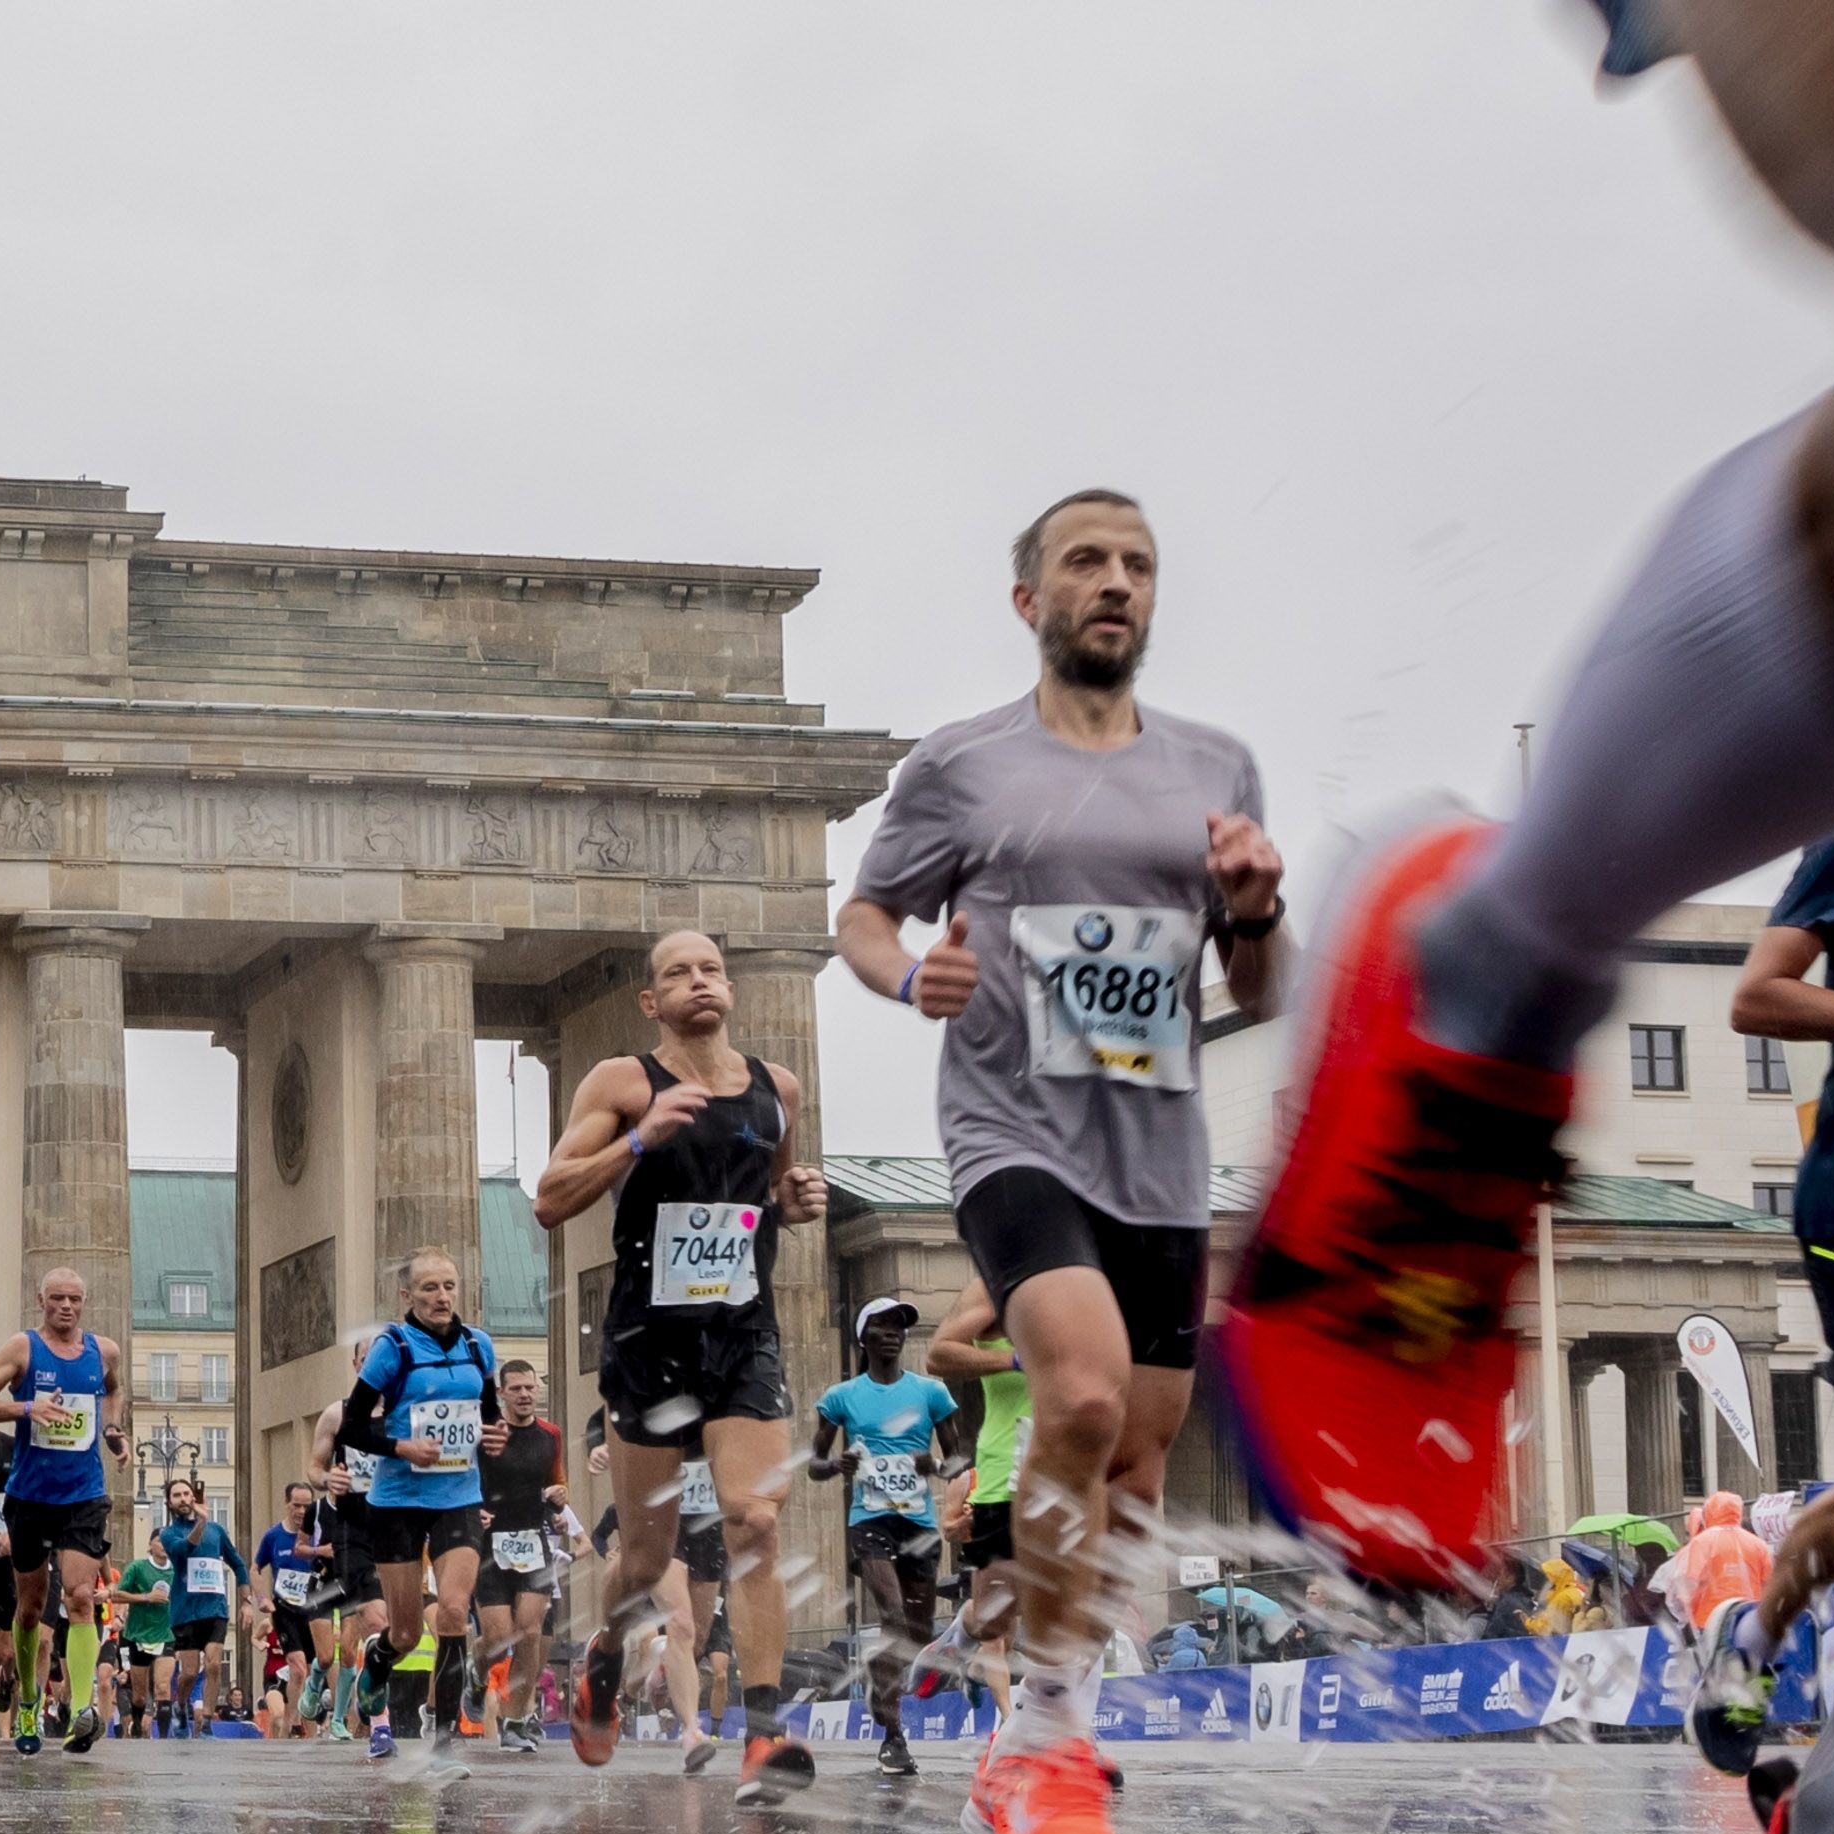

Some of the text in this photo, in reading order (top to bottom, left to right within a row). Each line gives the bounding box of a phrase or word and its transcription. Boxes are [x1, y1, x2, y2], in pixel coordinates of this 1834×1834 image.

[1045, 962, 1186, 1018] 16881
[671, 1237, 748, 1266] 70449
[698, 1268, 725, 1279] Leon
[426, 1424, 475, 1445] 51818
[1422, 1673, 1450, 1690] BMW
